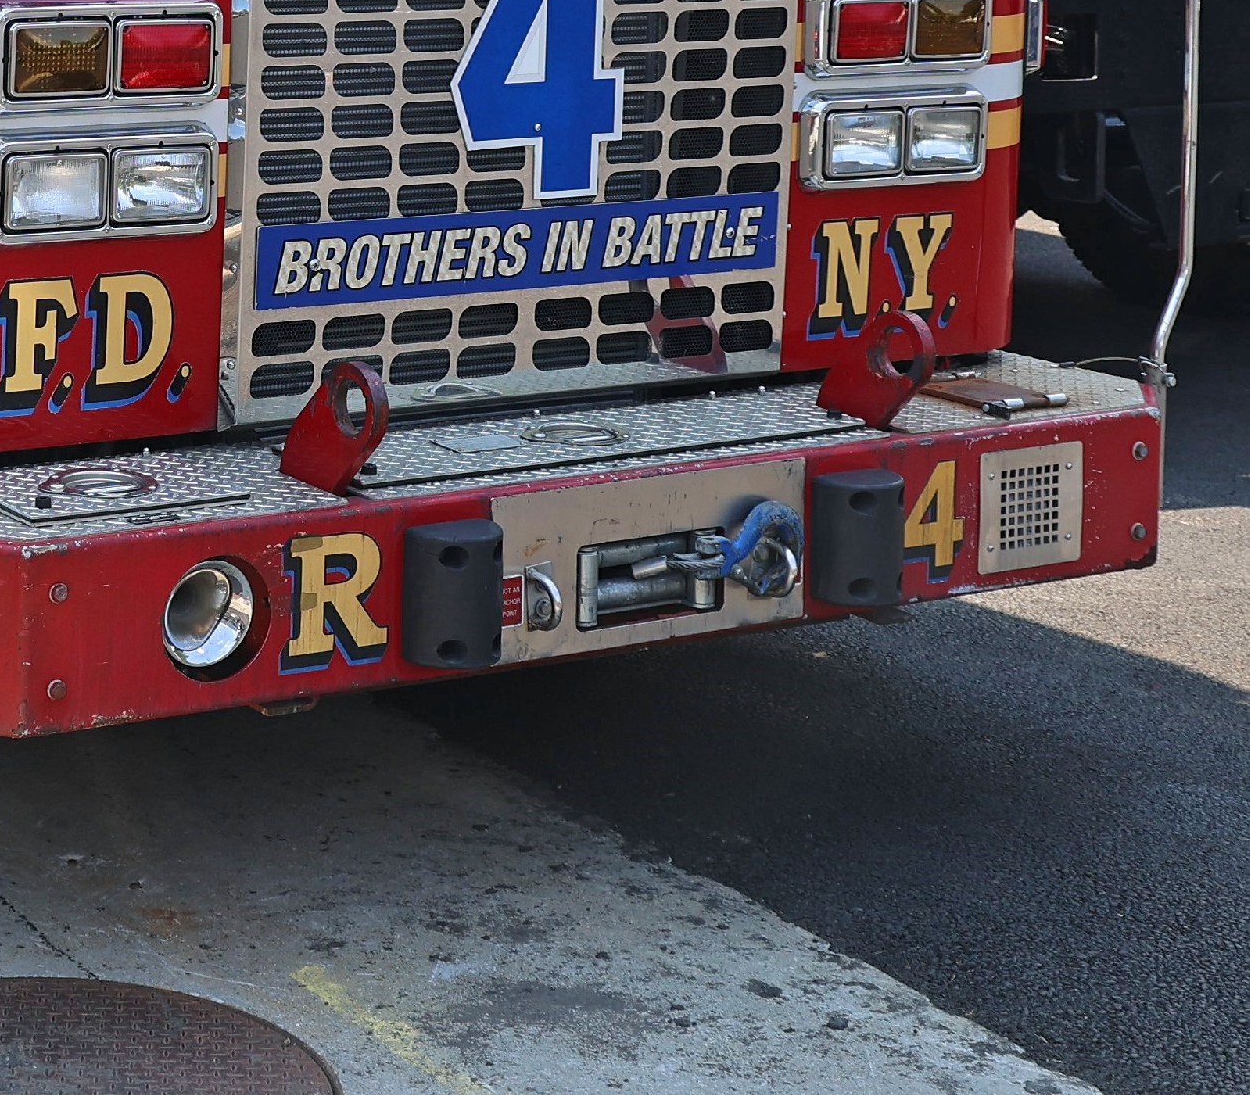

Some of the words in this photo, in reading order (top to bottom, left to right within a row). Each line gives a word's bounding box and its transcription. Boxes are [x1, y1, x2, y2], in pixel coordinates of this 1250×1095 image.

[273, 223, 531, 296] BROTHERS
[541, 218, 598, 275] IN
[601, 205, 765, 270] BATTLE
[904, 459, 965, 579] 4
[281, 534, 389, 673] R
